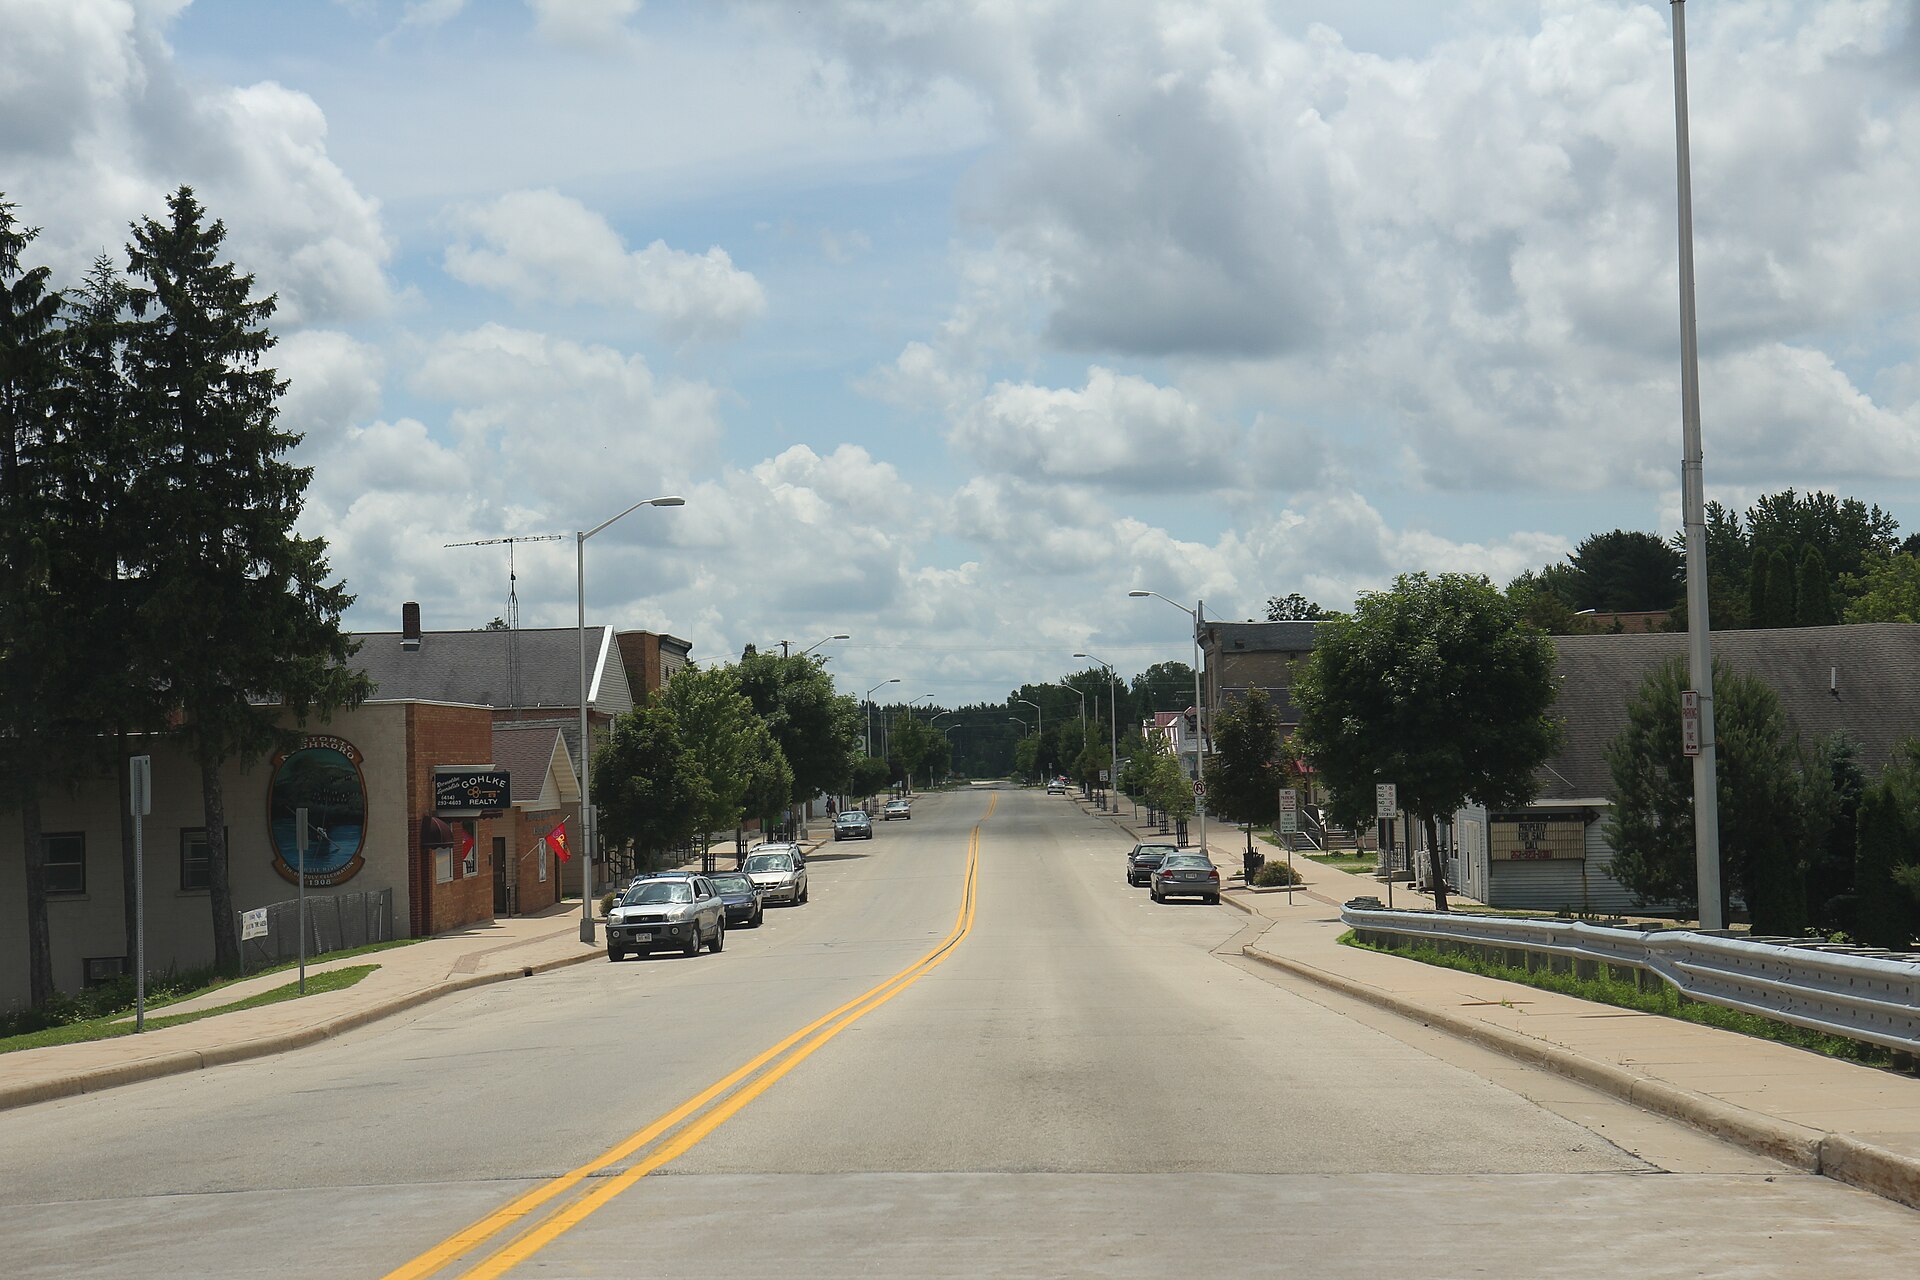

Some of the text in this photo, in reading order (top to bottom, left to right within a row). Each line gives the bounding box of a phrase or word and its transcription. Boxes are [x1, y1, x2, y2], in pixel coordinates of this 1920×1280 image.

[461, 775, 507, 789] GOHLKE
[1518, 823, 1547, 831] PROPERTY
[1531, 831, 1546, 840] SALE
[1525, 841, 1538, 849] CALL
